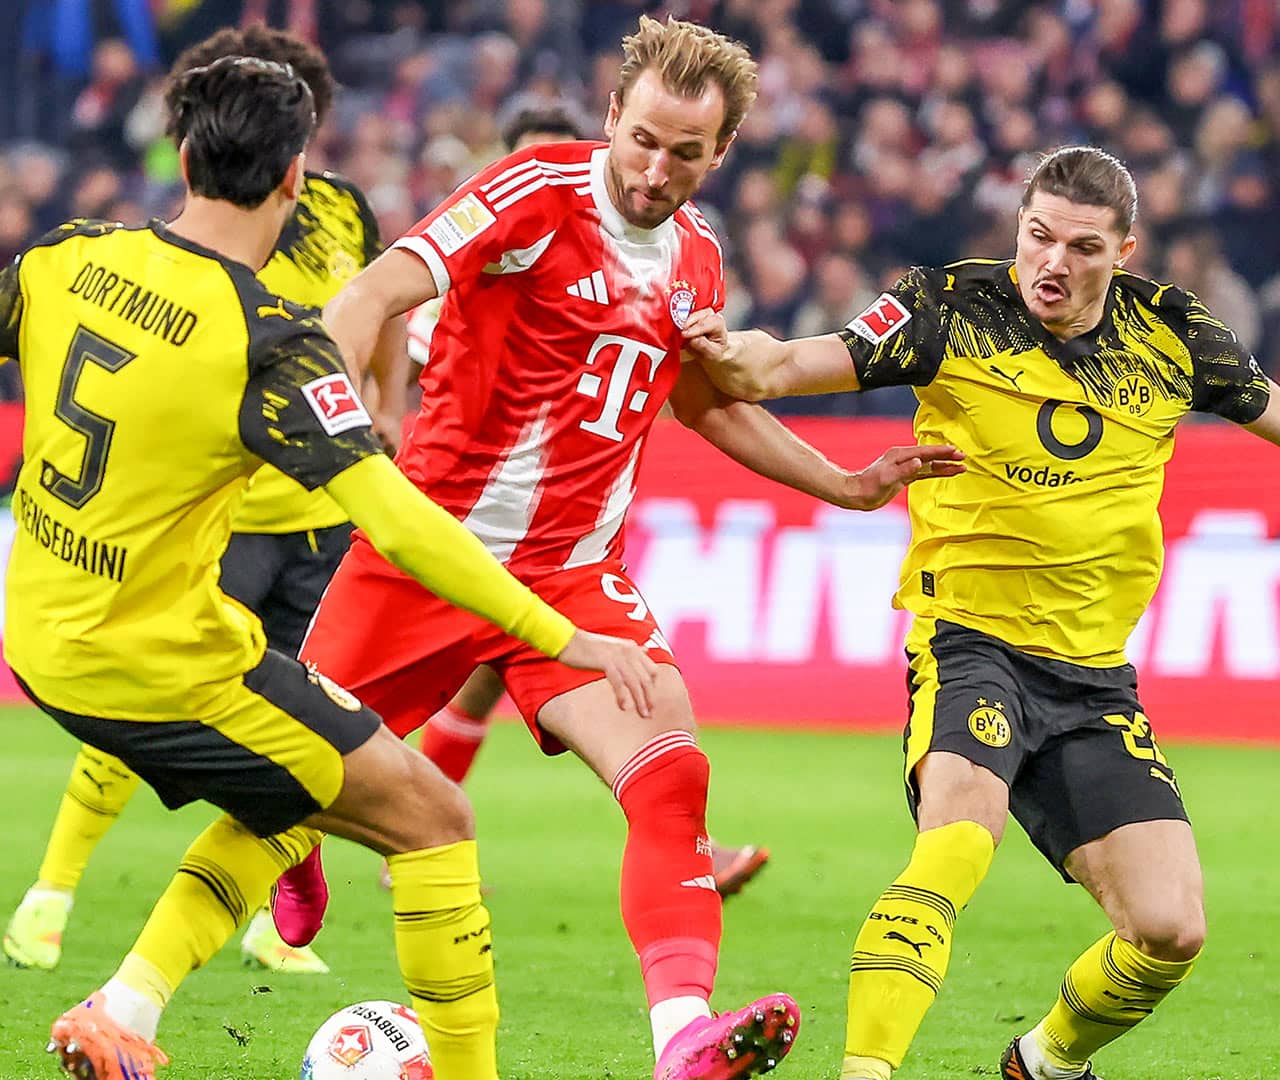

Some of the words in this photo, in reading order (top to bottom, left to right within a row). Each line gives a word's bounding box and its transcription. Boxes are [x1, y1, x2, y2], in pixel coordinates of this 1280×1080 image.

[68, 261, 198, 347] DORTMUND
[1118, 377, 1151, 406] BVB
[39, 323, 138, 511] 5
[1129, 404, 1141, 414] 09
[601, 572, 649, 621] 9
[975, 711, 1006, 738] BVB
[984, 732, 997, 742] 09
[869, 912, 919, 925] BVB
